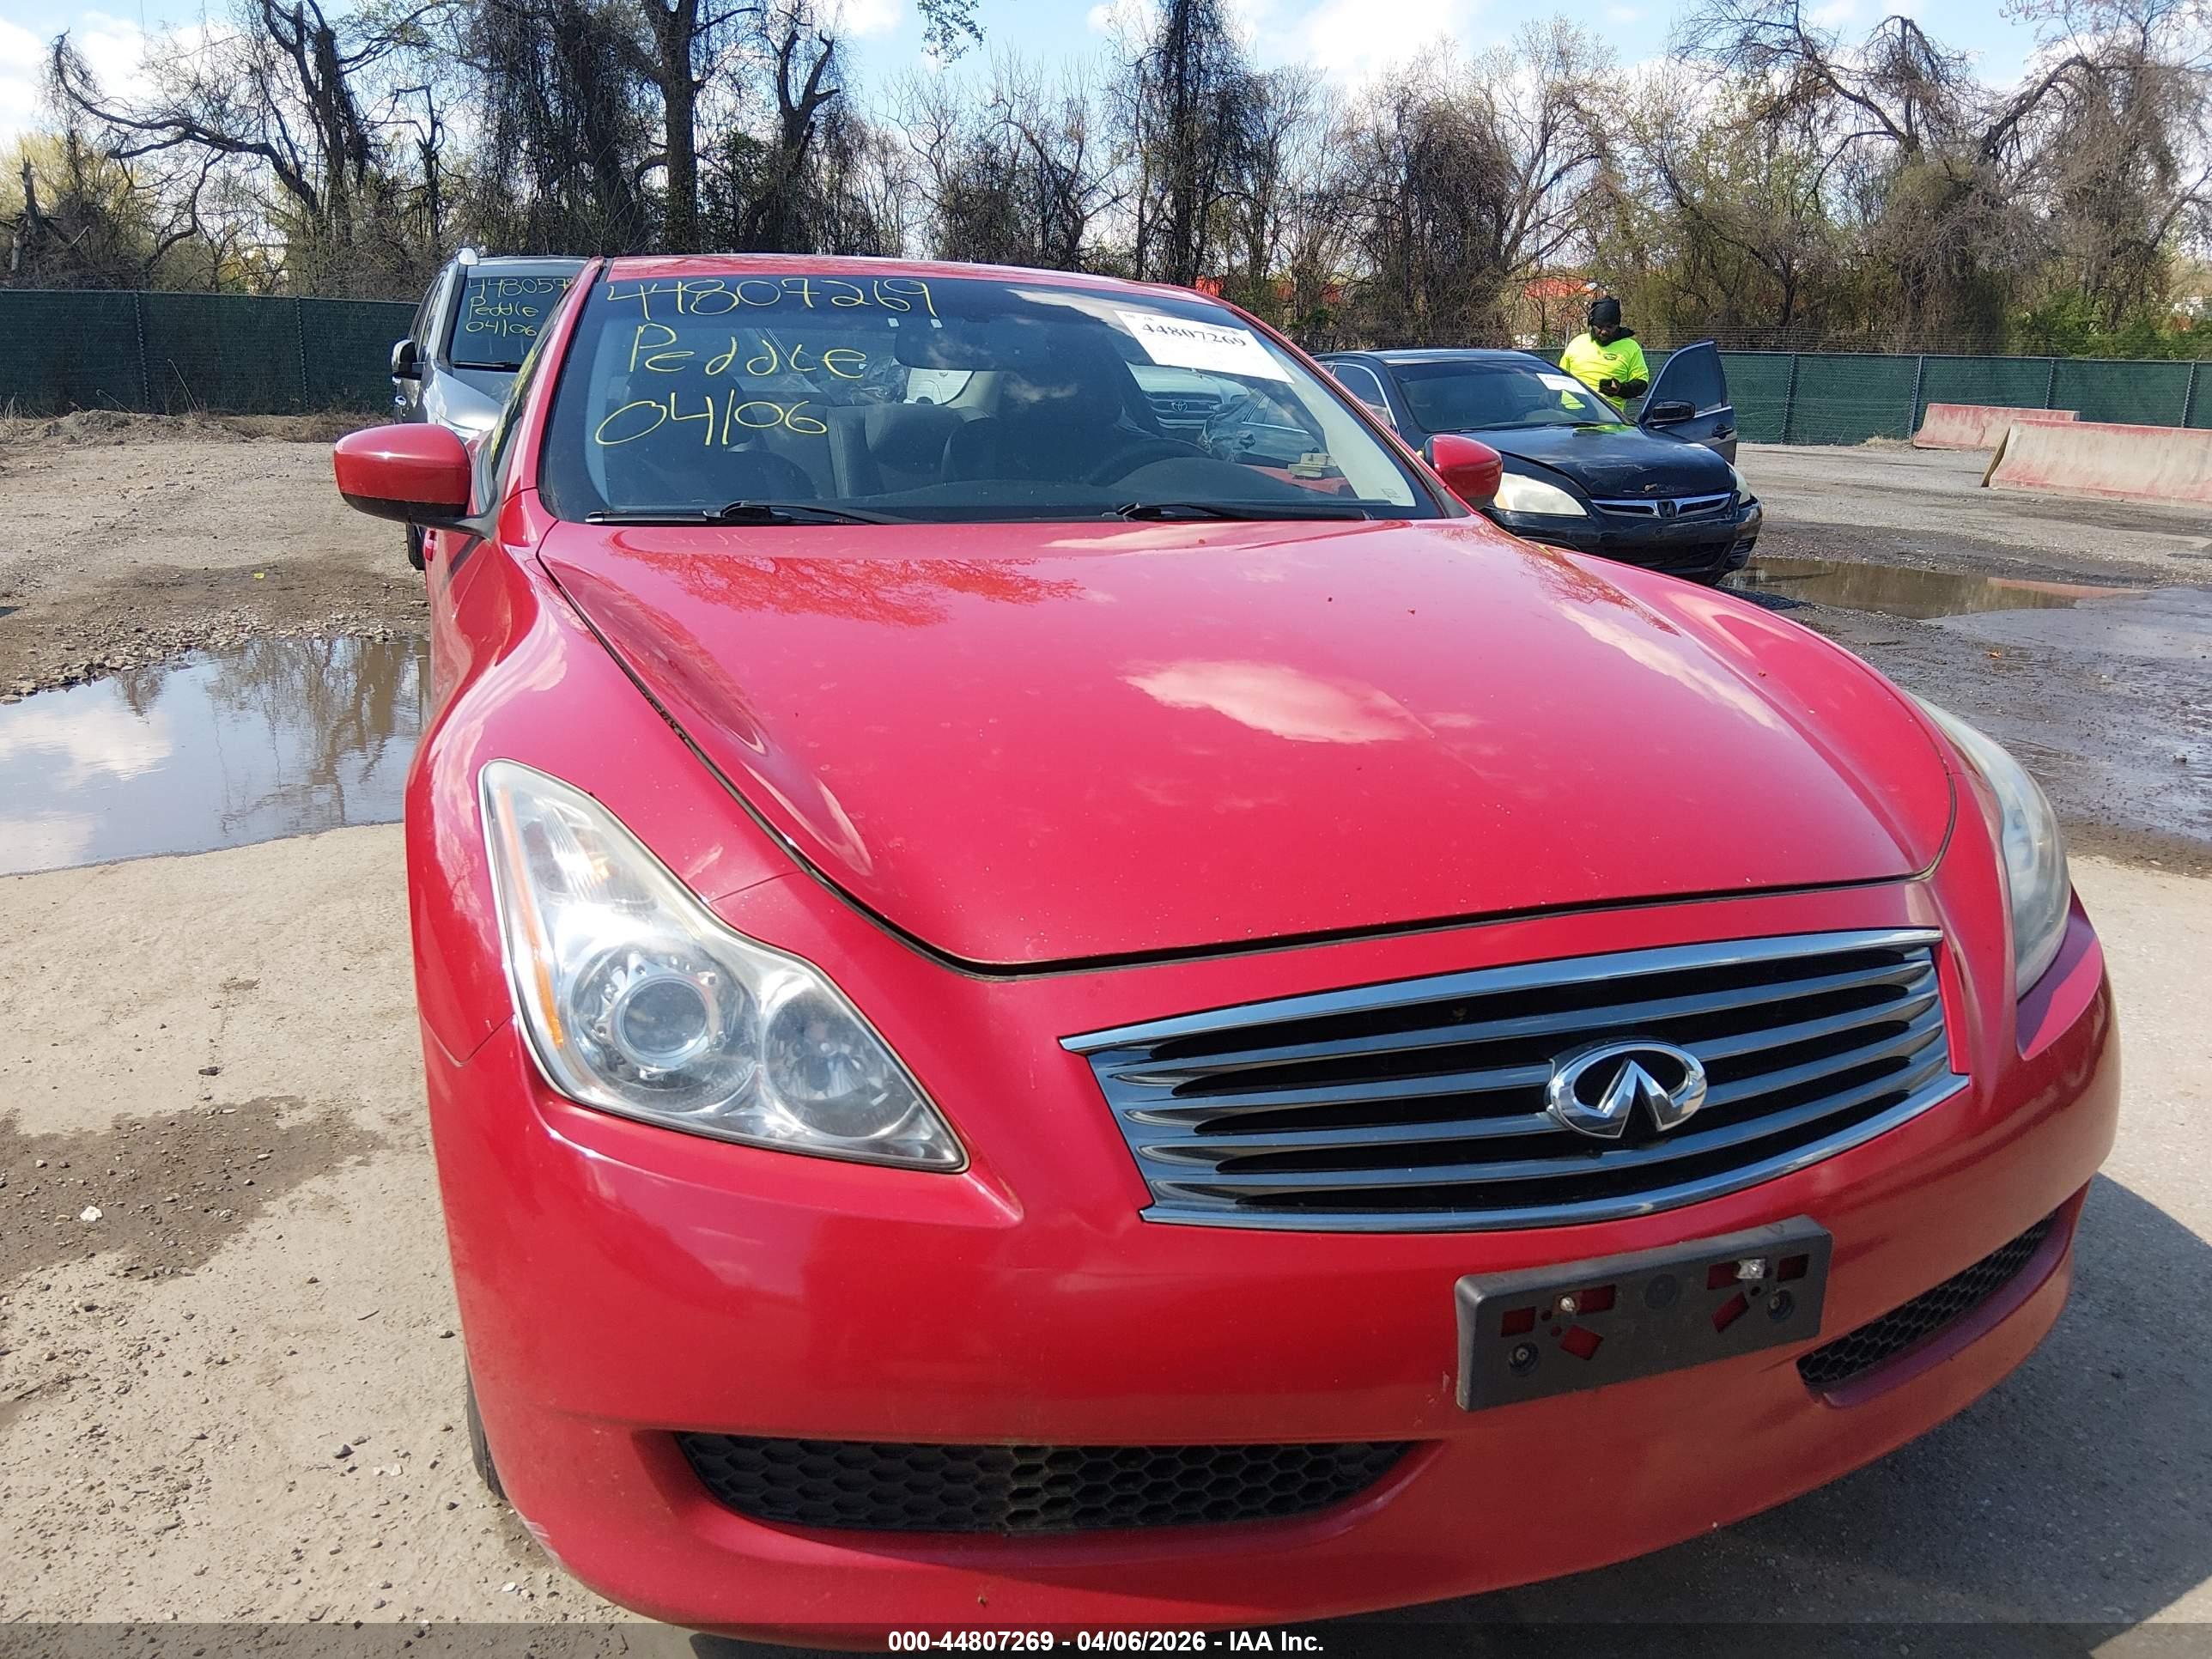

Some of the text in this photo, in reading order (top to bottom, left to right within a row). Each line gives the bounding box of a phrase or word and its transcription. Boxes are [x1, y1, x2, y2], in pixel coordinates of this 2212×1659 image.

[470, 295, 539, 319] Peddle
[606, 278, 939, 321] 44807269
[466, 319, 538, 337] 04/06
[1142, 323, 1247, 346] 44807269
[595, 389, 828, 447] 04/06
